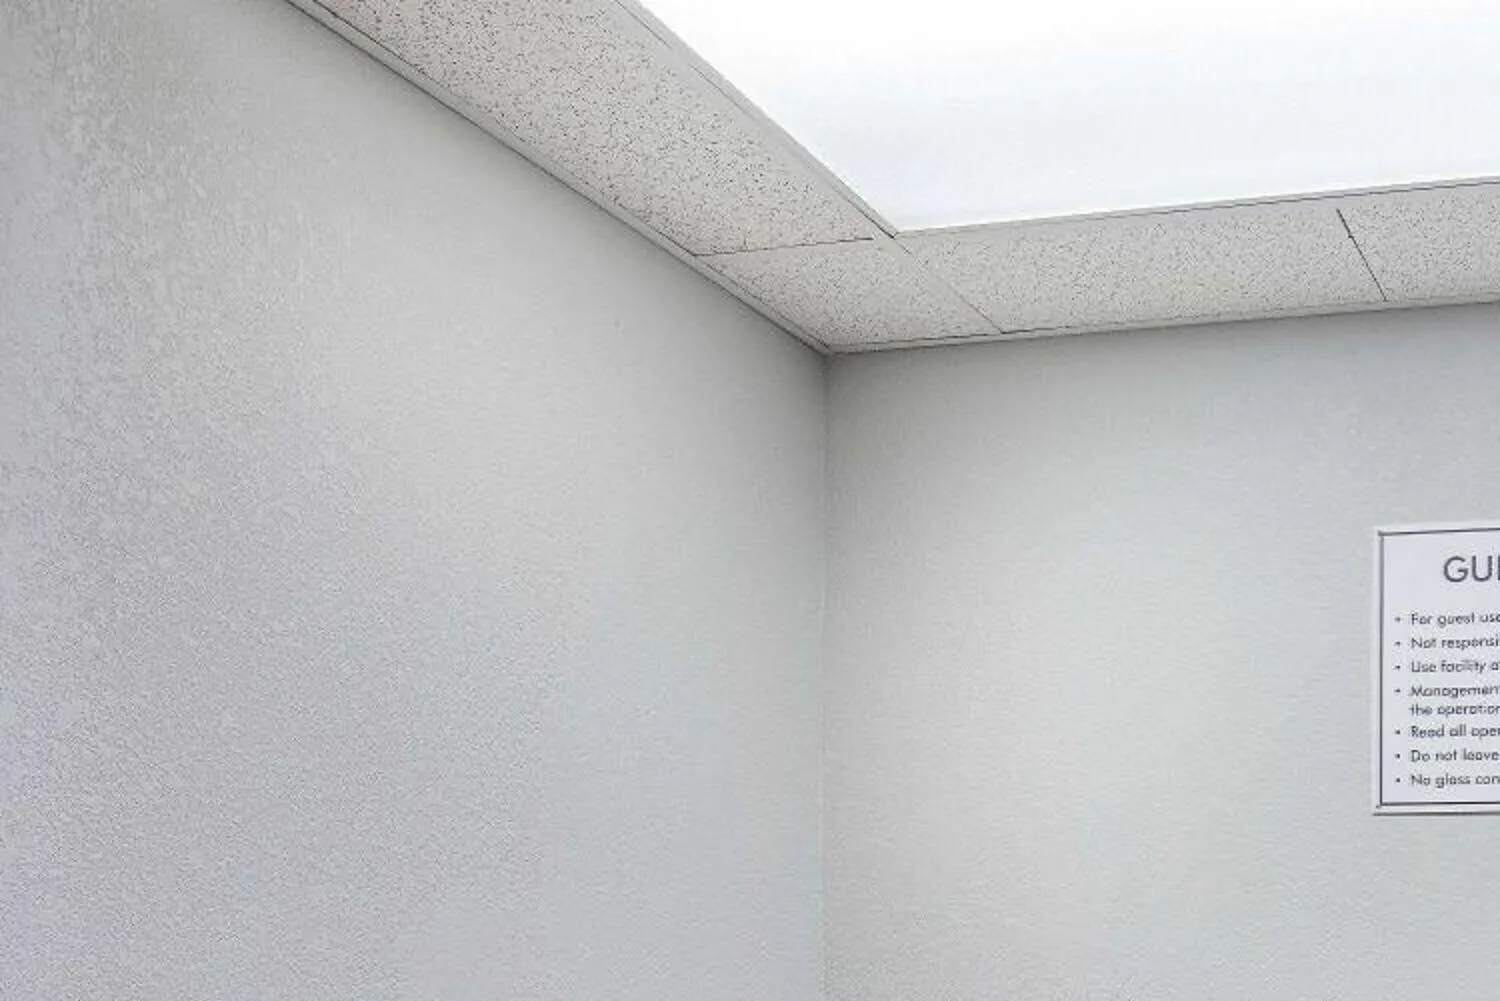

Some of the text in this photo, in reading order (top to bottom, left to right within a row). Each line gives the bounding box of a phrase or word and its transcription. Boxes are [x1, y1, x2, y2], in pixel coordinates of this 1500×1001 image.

[1411, 612, 1433, 625] For
[1438, 612, 1476, 629] guest
[1411, 637, 1436, 649] Not
[1411, 662, 1436, 673] Use
[1440, 660, 1486, 675] facility
[1410, 704, 1432, 716] the
[1411, 725, 1445, 738] Read
[1449, 724, 1467, 736] all
[1411, 750, 1430, 762] Do
[1434, 749, 1457, 761] not
[1462, 748, 1499, 761] leave
[1411, 774, 1430, 786] No
[1435, 773, 1470, 789] glass
